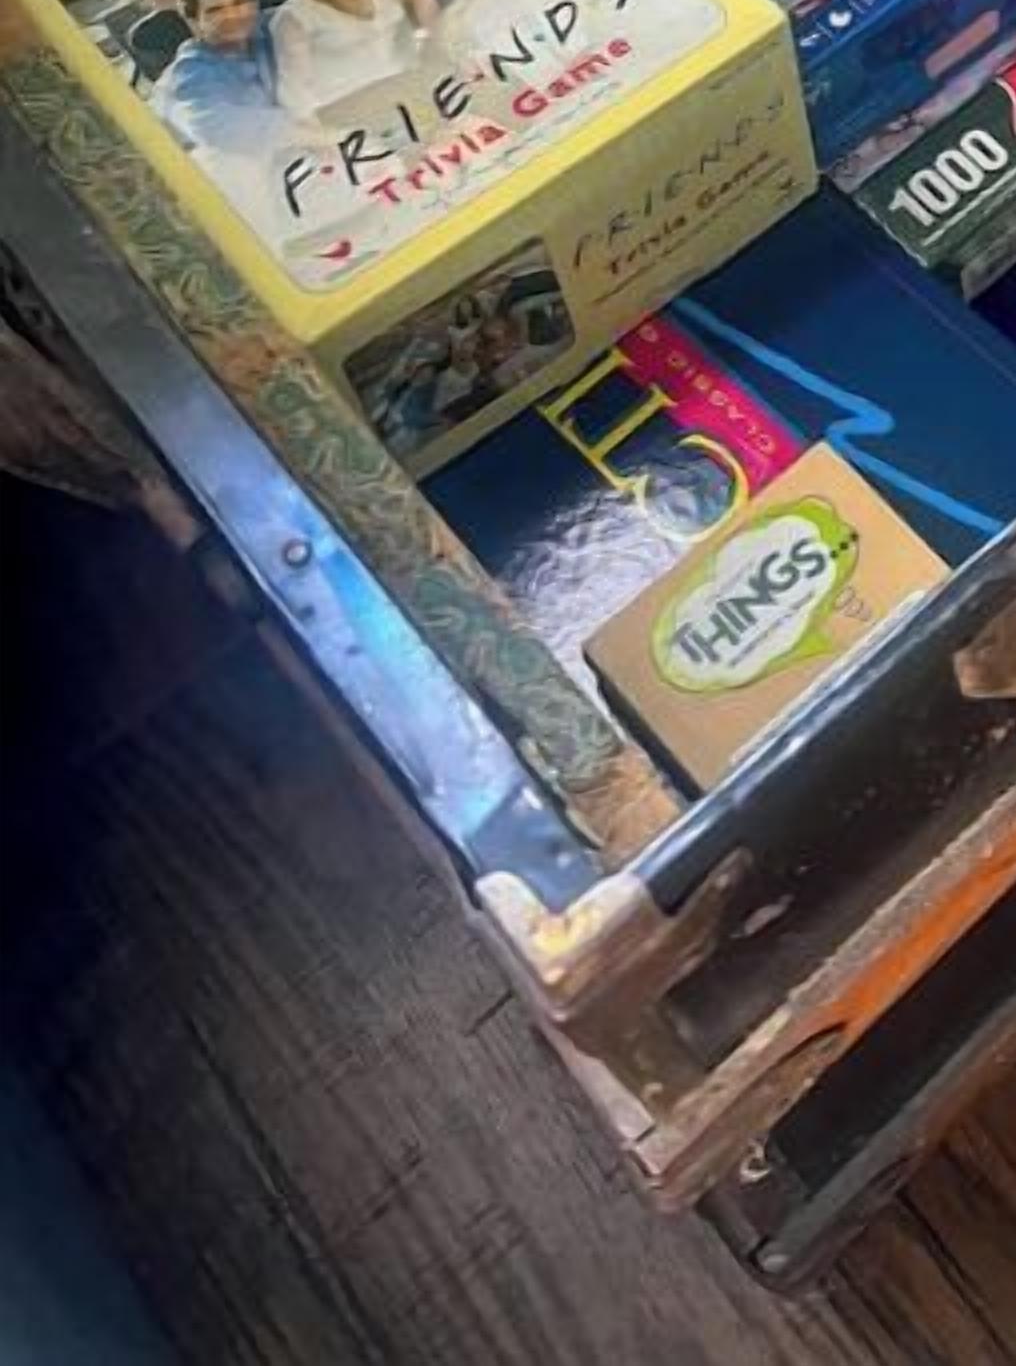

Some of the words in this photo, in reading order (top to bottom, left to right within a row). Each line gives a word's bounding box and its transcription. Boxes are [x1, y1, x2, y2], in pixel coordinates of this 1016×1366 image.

[368, 124, 508, 203] Trivia
[511, 38, 632, 117] Game
[890, 128, 1008, 228] 1000
